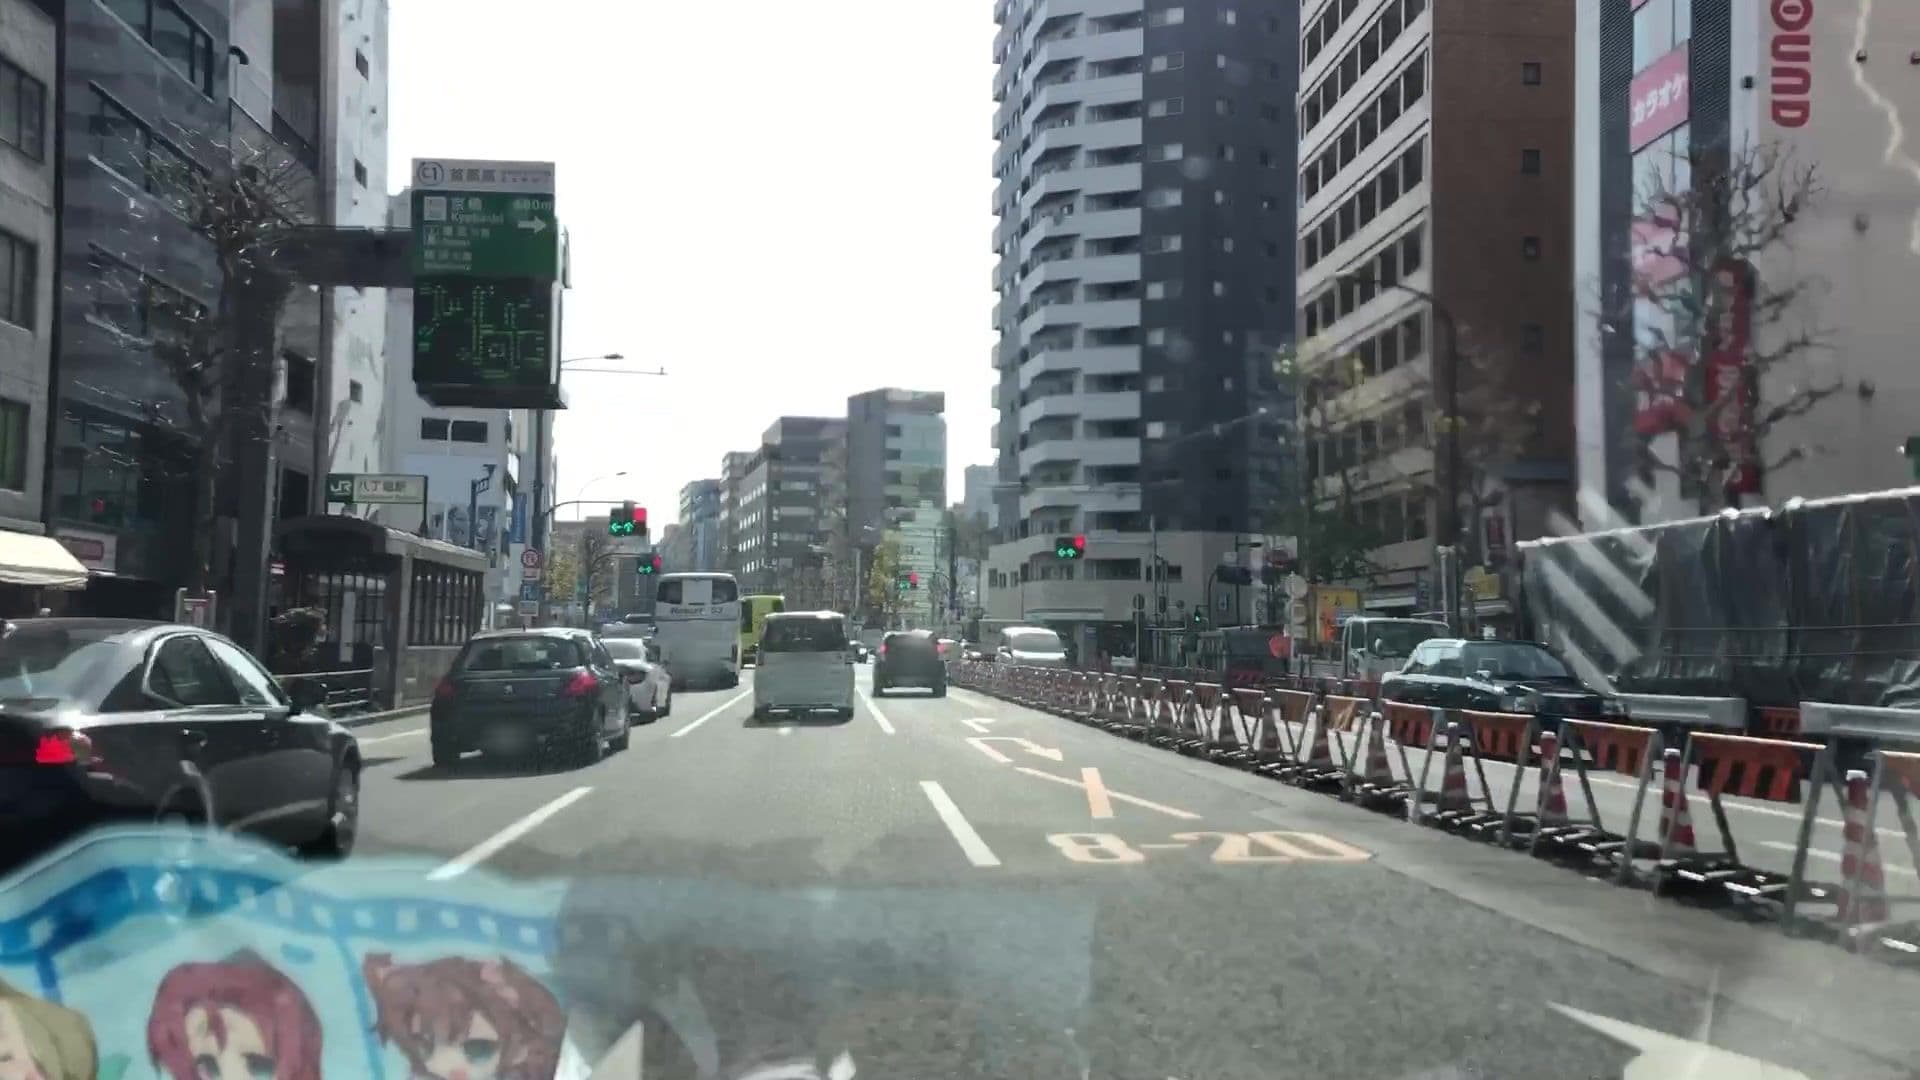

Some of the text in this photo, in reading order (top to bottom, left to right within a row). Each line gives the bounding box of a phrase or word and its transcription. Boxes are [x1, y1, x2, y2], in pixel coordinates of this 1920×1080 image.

[1632, 73, 1687, 126] カラオケ
[329, 480, 352, 495] JR
[1047, 831, 1375, 864] 8-20
